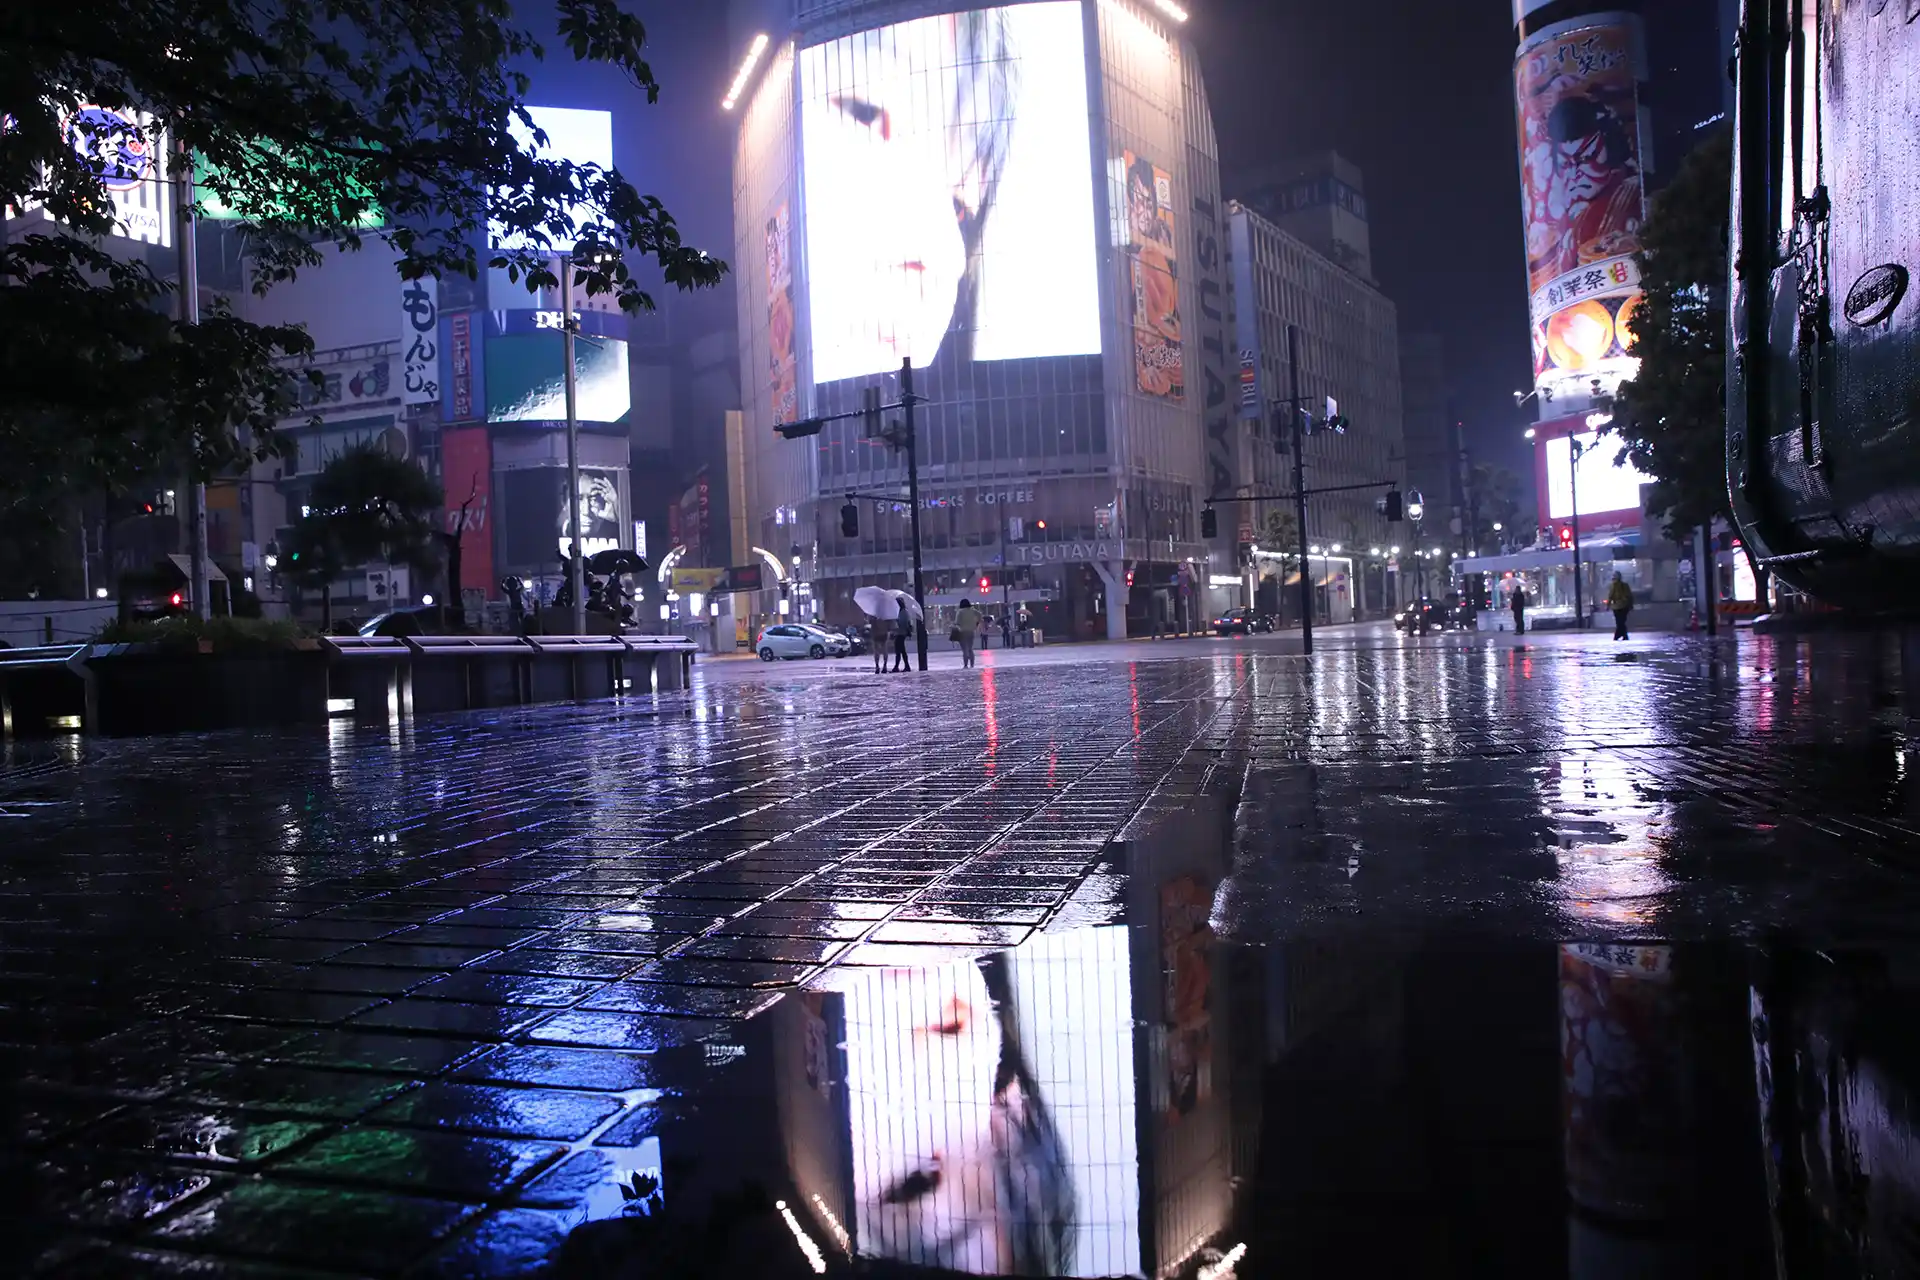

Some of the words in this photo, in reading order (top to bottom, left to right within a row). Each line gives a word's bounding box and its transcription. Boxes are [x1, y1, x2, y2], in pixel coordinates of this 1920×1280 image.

[123, 211, 158, 228] VISA
[403, 280, 438, 399] もんじゃ
[1194, 193, 1231, 500] TSUTAYA
[1240, 349, 1256, 406] SEIBU
[876, 494, 966, 514] SBUCKS
[975, 490, 1035, 506] COFFEE
[448, 507, 487, 532] クスリ
[1018, 543, 1109, 561] TSUTAYA
